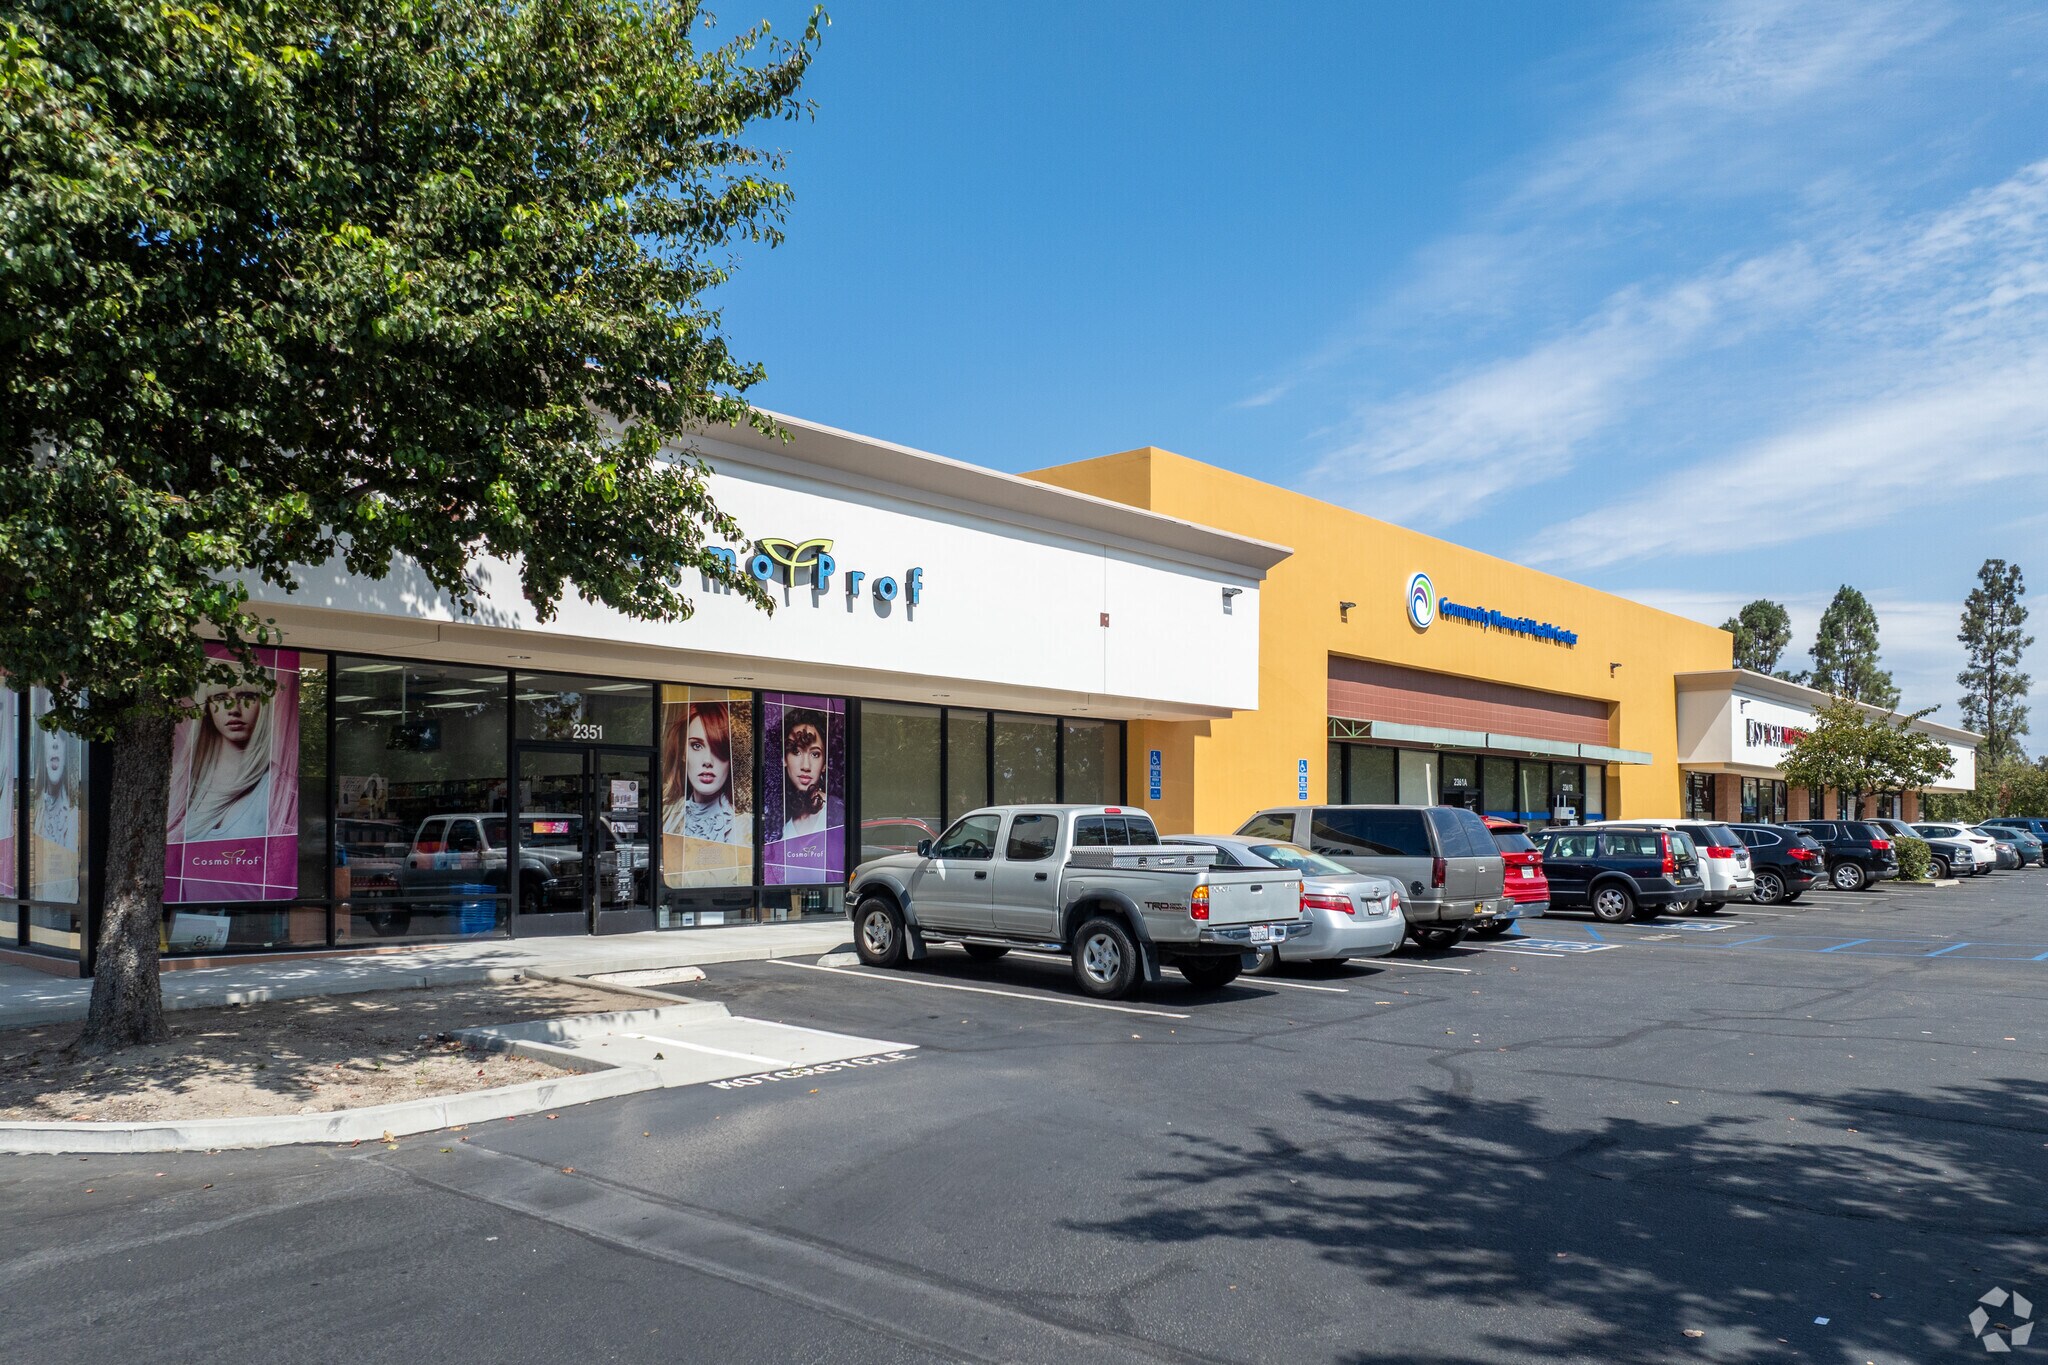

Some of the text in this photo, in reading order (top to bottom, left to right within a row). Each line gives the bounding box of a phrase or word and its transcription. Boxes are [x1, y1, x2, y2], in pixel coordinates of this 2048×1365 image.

[812, 552, 923, 604] Prof
[1438, 597, 1578, 645] Community Memorial Health Center
[572, 724, 603, 740] 2351
[192, 856, 259, 866] Cosmo Prof
[1144, 901, 1169, 911] TRD
[708, 1052, 917, 1090] MOTORCYCLE
